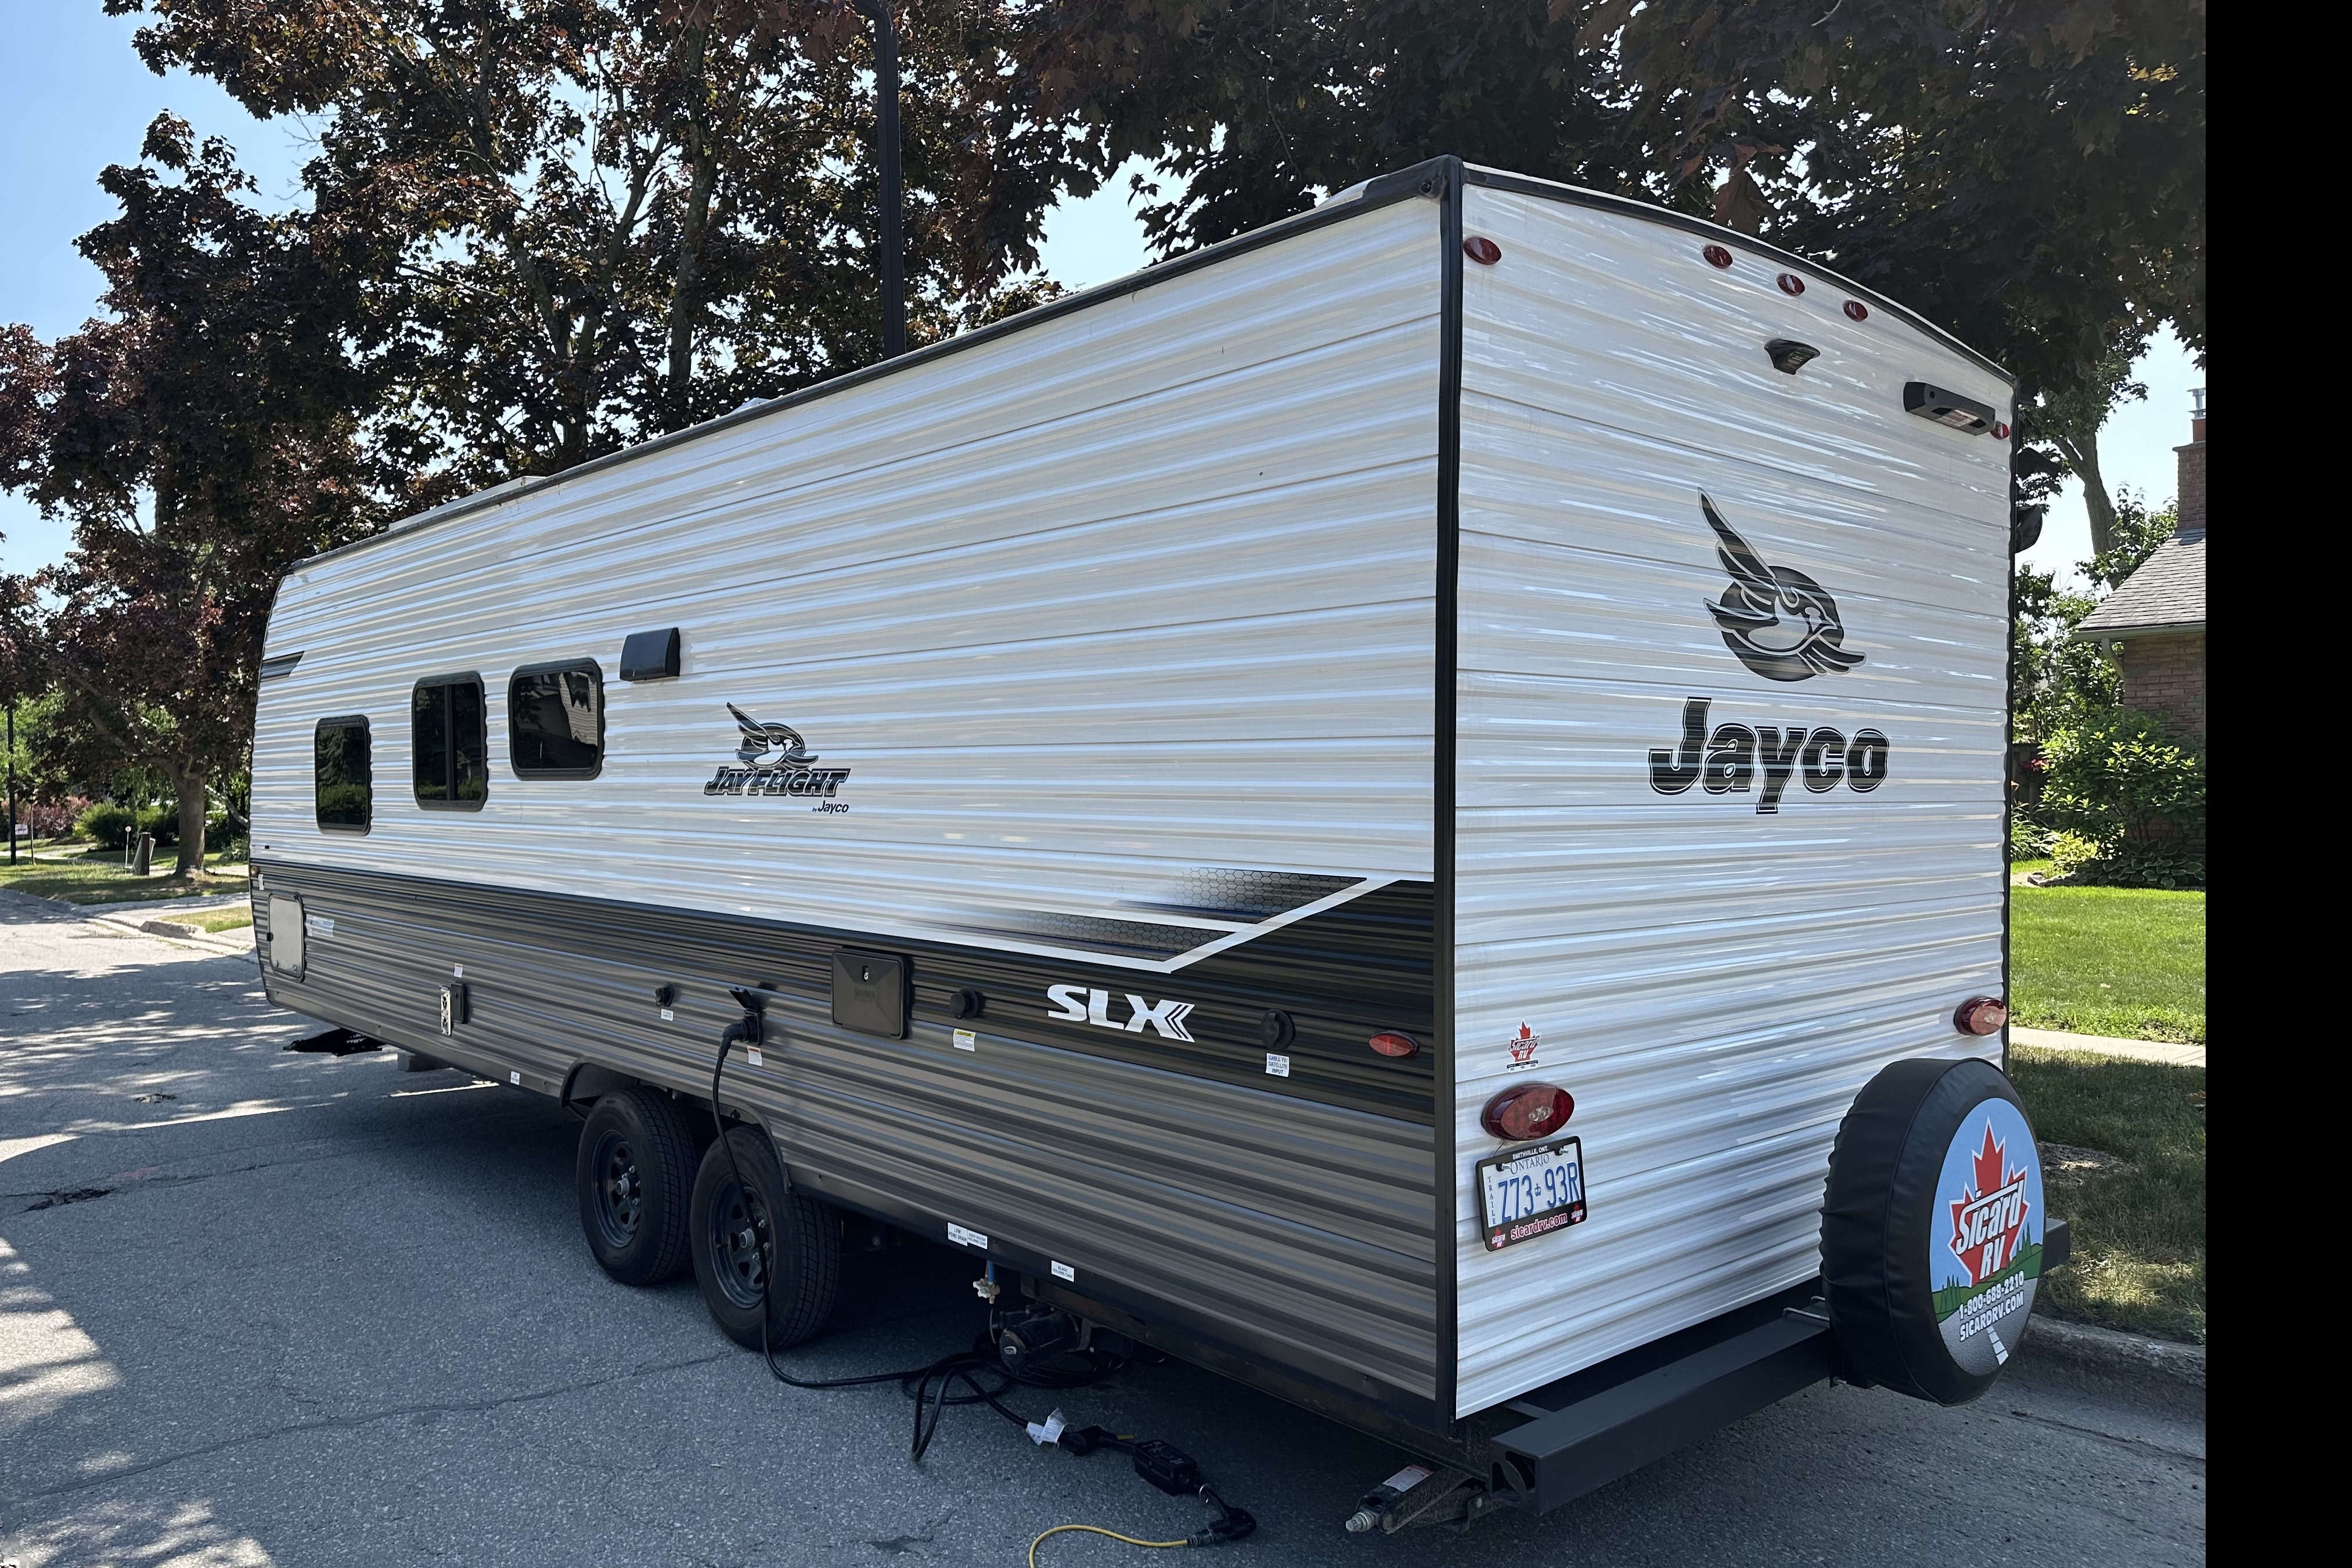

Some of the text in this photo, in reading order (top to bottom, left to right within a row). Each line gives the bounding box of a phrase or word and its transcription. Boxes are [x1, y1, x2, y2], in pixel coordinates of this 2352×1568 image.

[1649, 696, 1890, 814] Jayco
[704, 766, 851, 797] JAY FLIGHT
[817, 800, 849, 814] Jayco
[853, 988, 876, 999] SHOWER
[1047, 984, 1195, 1043] SLX
[1509, 1036, 1540, 1051] Sicard
[1517, 1049, 1529, 1060] RV
[1268, 1061, 1288, 1069] SATELLITE
[1510, 1154, 1550, 1175] ONTARIO
[1510, 1212, 1568, 1241] sicardrv.com
[1955, 1179, 2025, 1255] Sicard
[1979, 1234, 2006, 1280] RV
[1959, 1270, 2025, 1320] 1-800-688-2210
[1960, 1291, 2024, 1342] SICARDRV.COM
